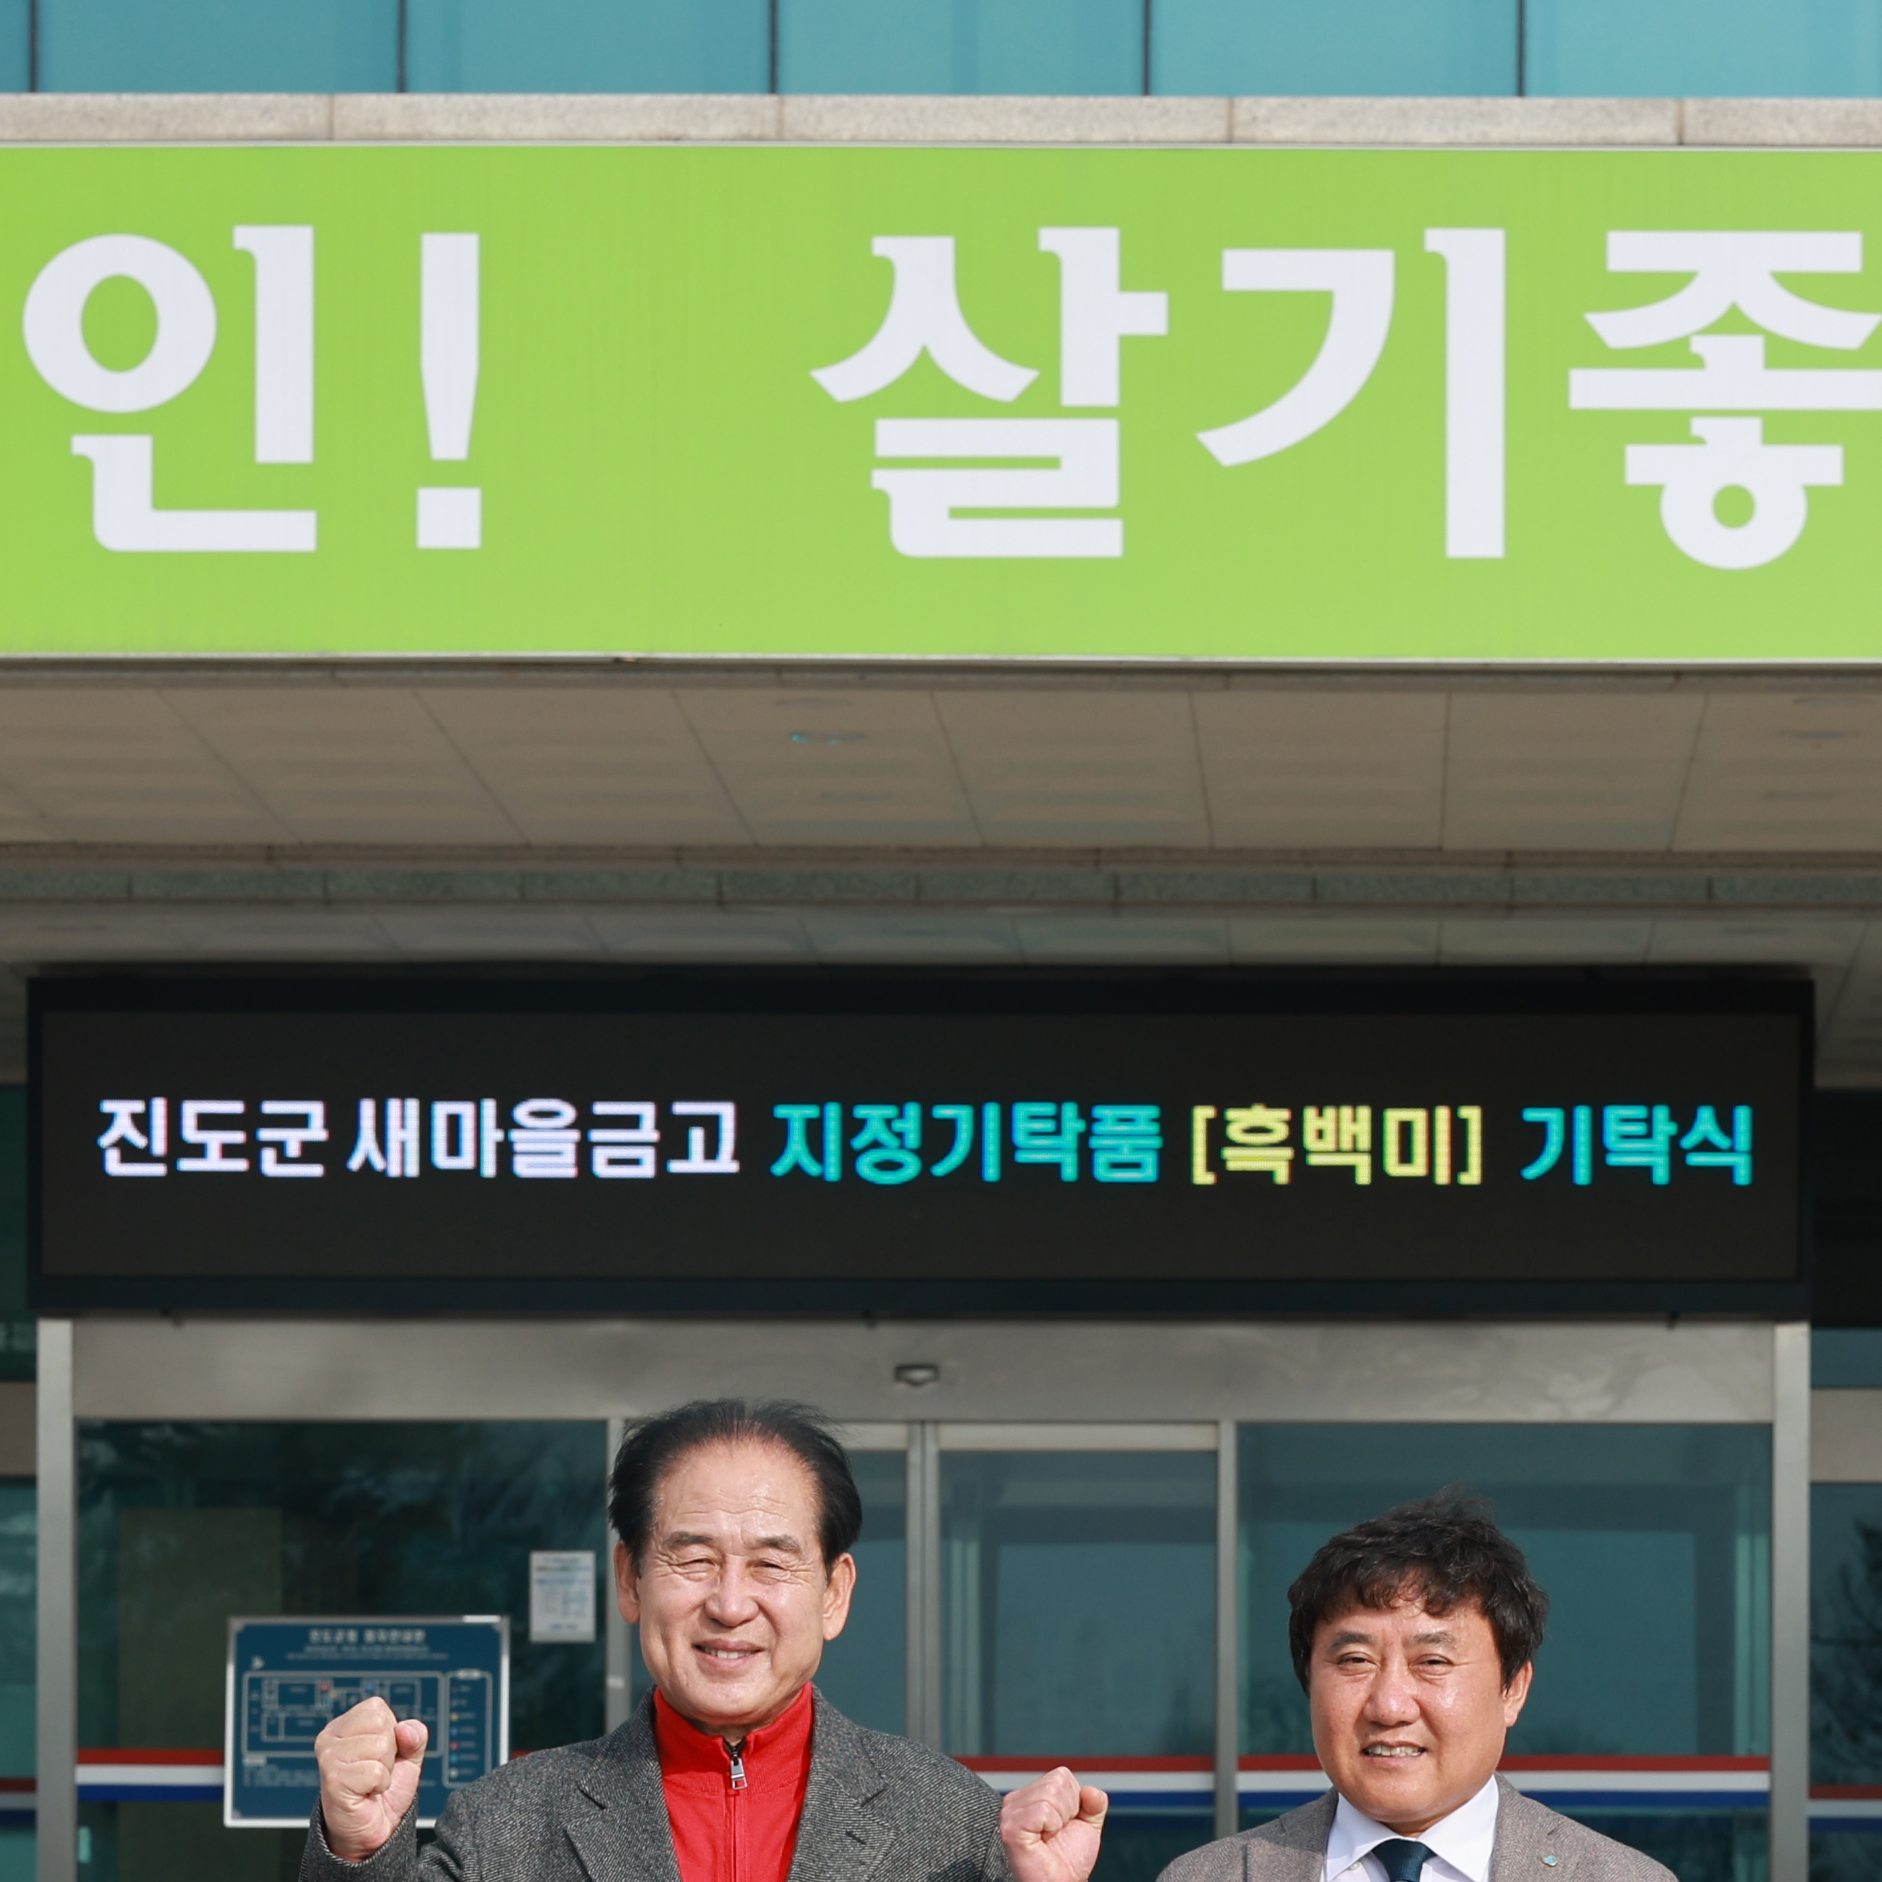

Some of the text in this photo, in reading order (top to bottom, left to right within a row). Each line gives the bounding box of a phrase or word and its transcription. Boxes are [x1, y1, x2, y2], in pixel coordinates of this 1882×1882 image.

[97, 1097, 1751, 1185] 진도군 새마을금고 지정기탁품 [흑백미] 기탁식
